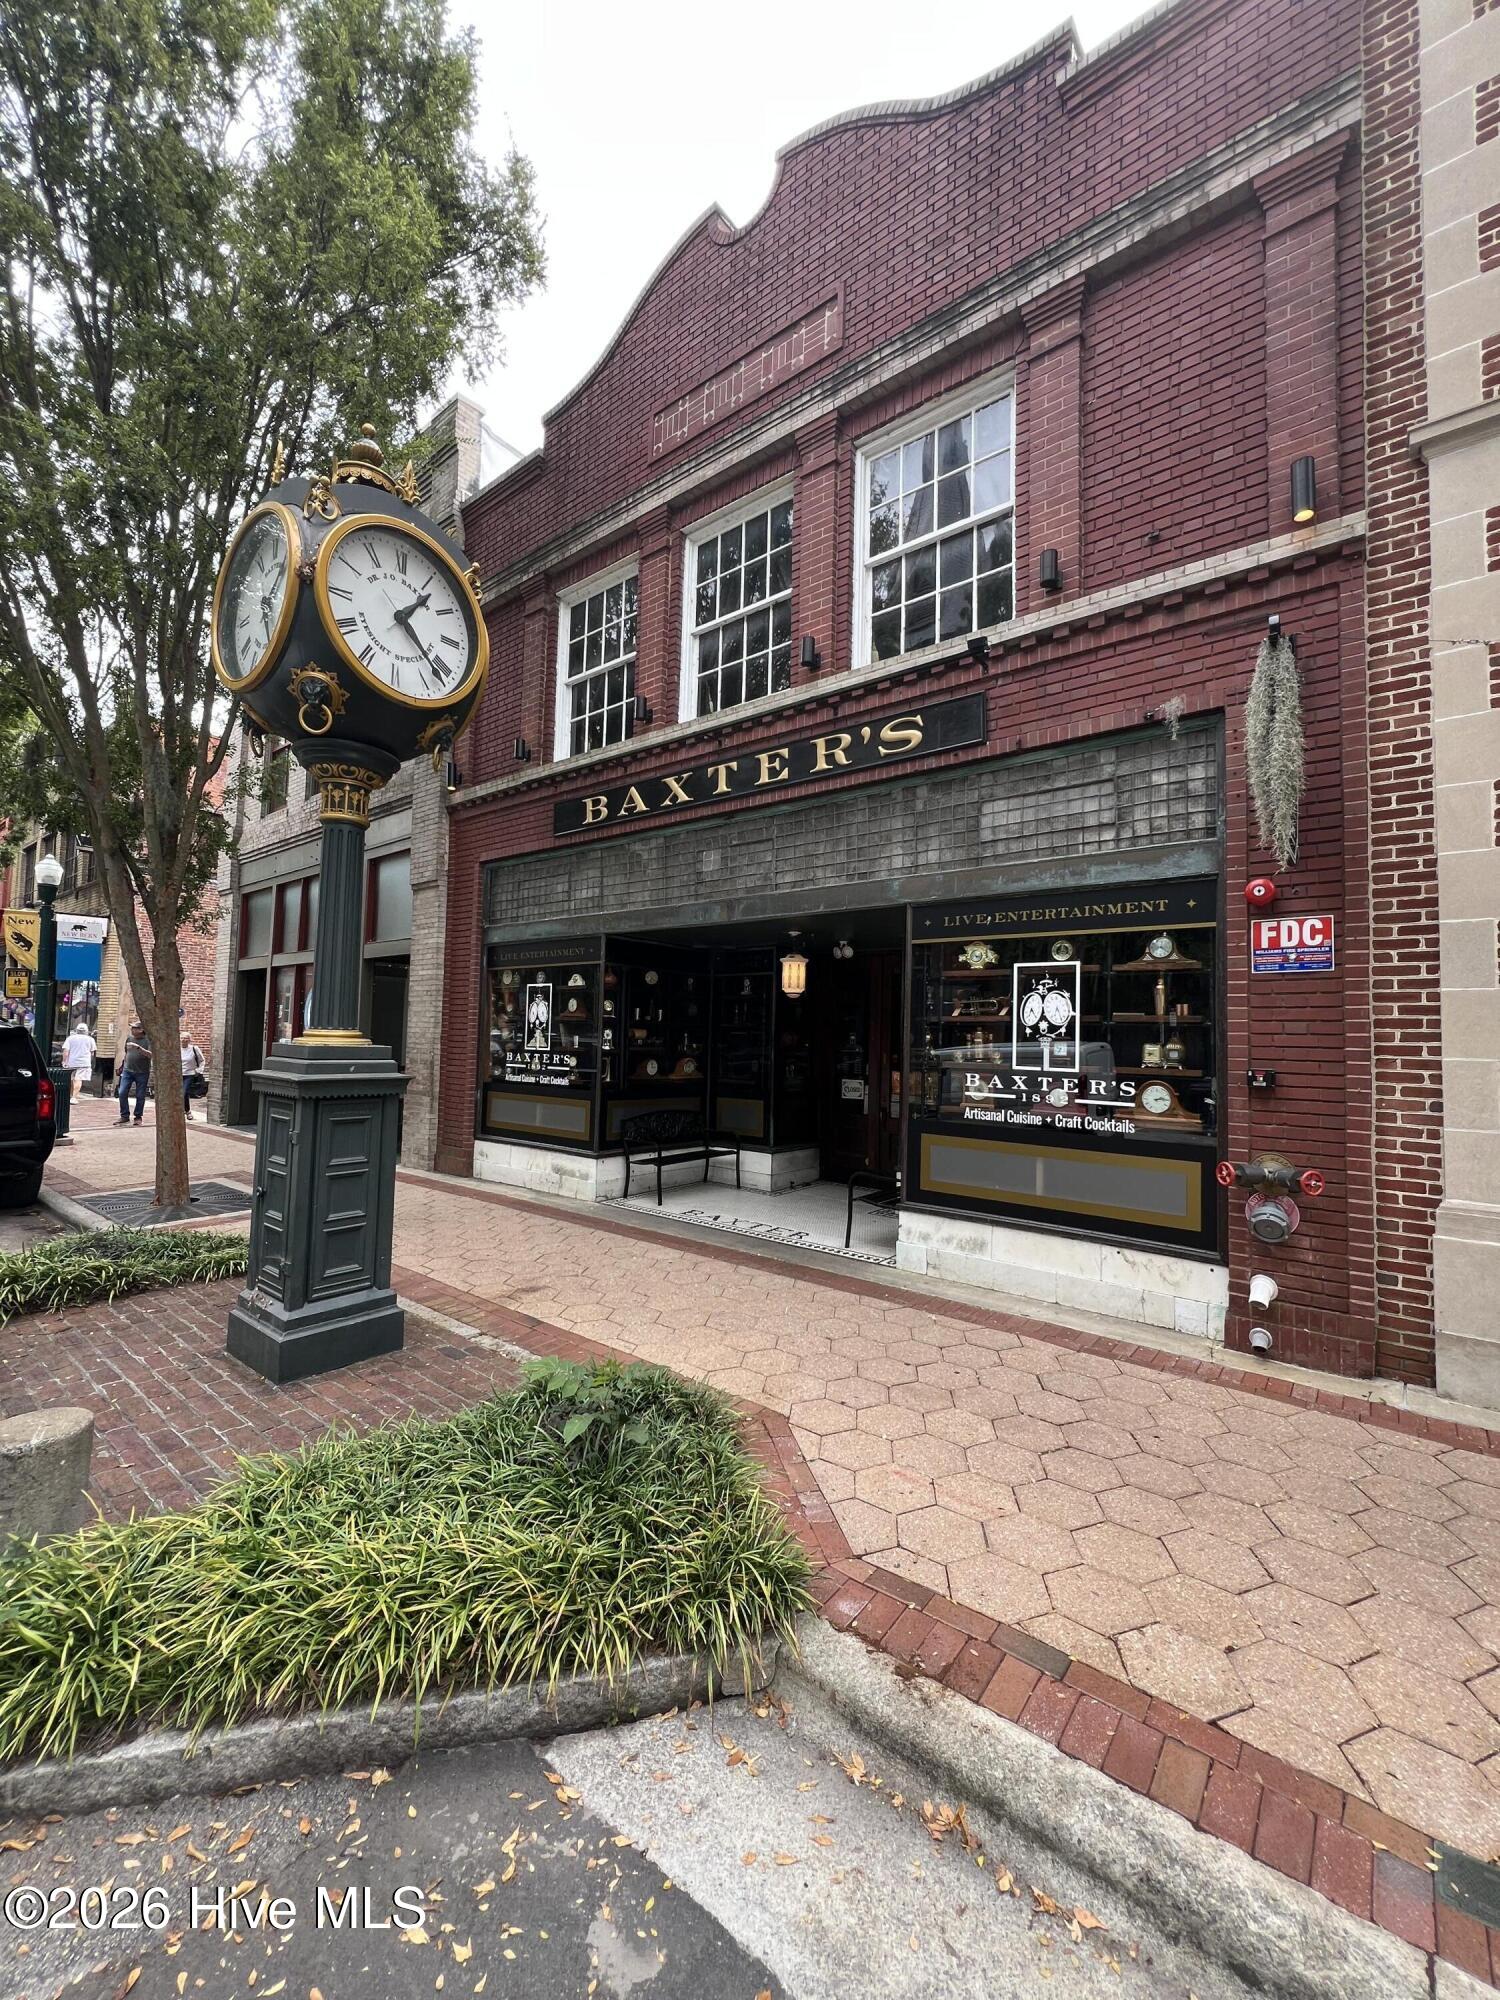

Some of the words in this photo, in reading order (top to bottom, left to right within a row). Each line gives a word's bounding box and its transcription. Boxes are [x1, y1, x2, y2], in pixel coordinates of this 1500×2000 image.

[401, 578, 431, 611] BAXR
[435, 608, 454, 616] II
[358, 611, 392, 656] EYESIGHT
[394, 642, 435, 664] SPECIAST
[440, 634, 460, 650] III
[581, 714, 924, 825] BAXTER'S
[8, 916, 35, 925] New
[944, 914, 988, 927] LIVE
[994, 899, 1169, 923] ENTERTAINMENT
[1261, 918, 1324, 949] FDC
[500, 952, 517, 961] LIVE
[519, 947, 586, 960] ENTERTAINMENT
[506, 1051, 571, 1065] BAXTER'S
[964, 1072, 1137, 1097] BAXTER'S
[1021, 1092, 1069, 1106] 1892
[964, 1106, 1005, 1122] Artisanal
[1006, 1108, 1042, 1126] Cuisine
[1054, 1113, 1083, 1129] Craft
[1084, 1116, 1136, 1134] Cocktails
[680, 1209, 810, 1240] BAXTER
